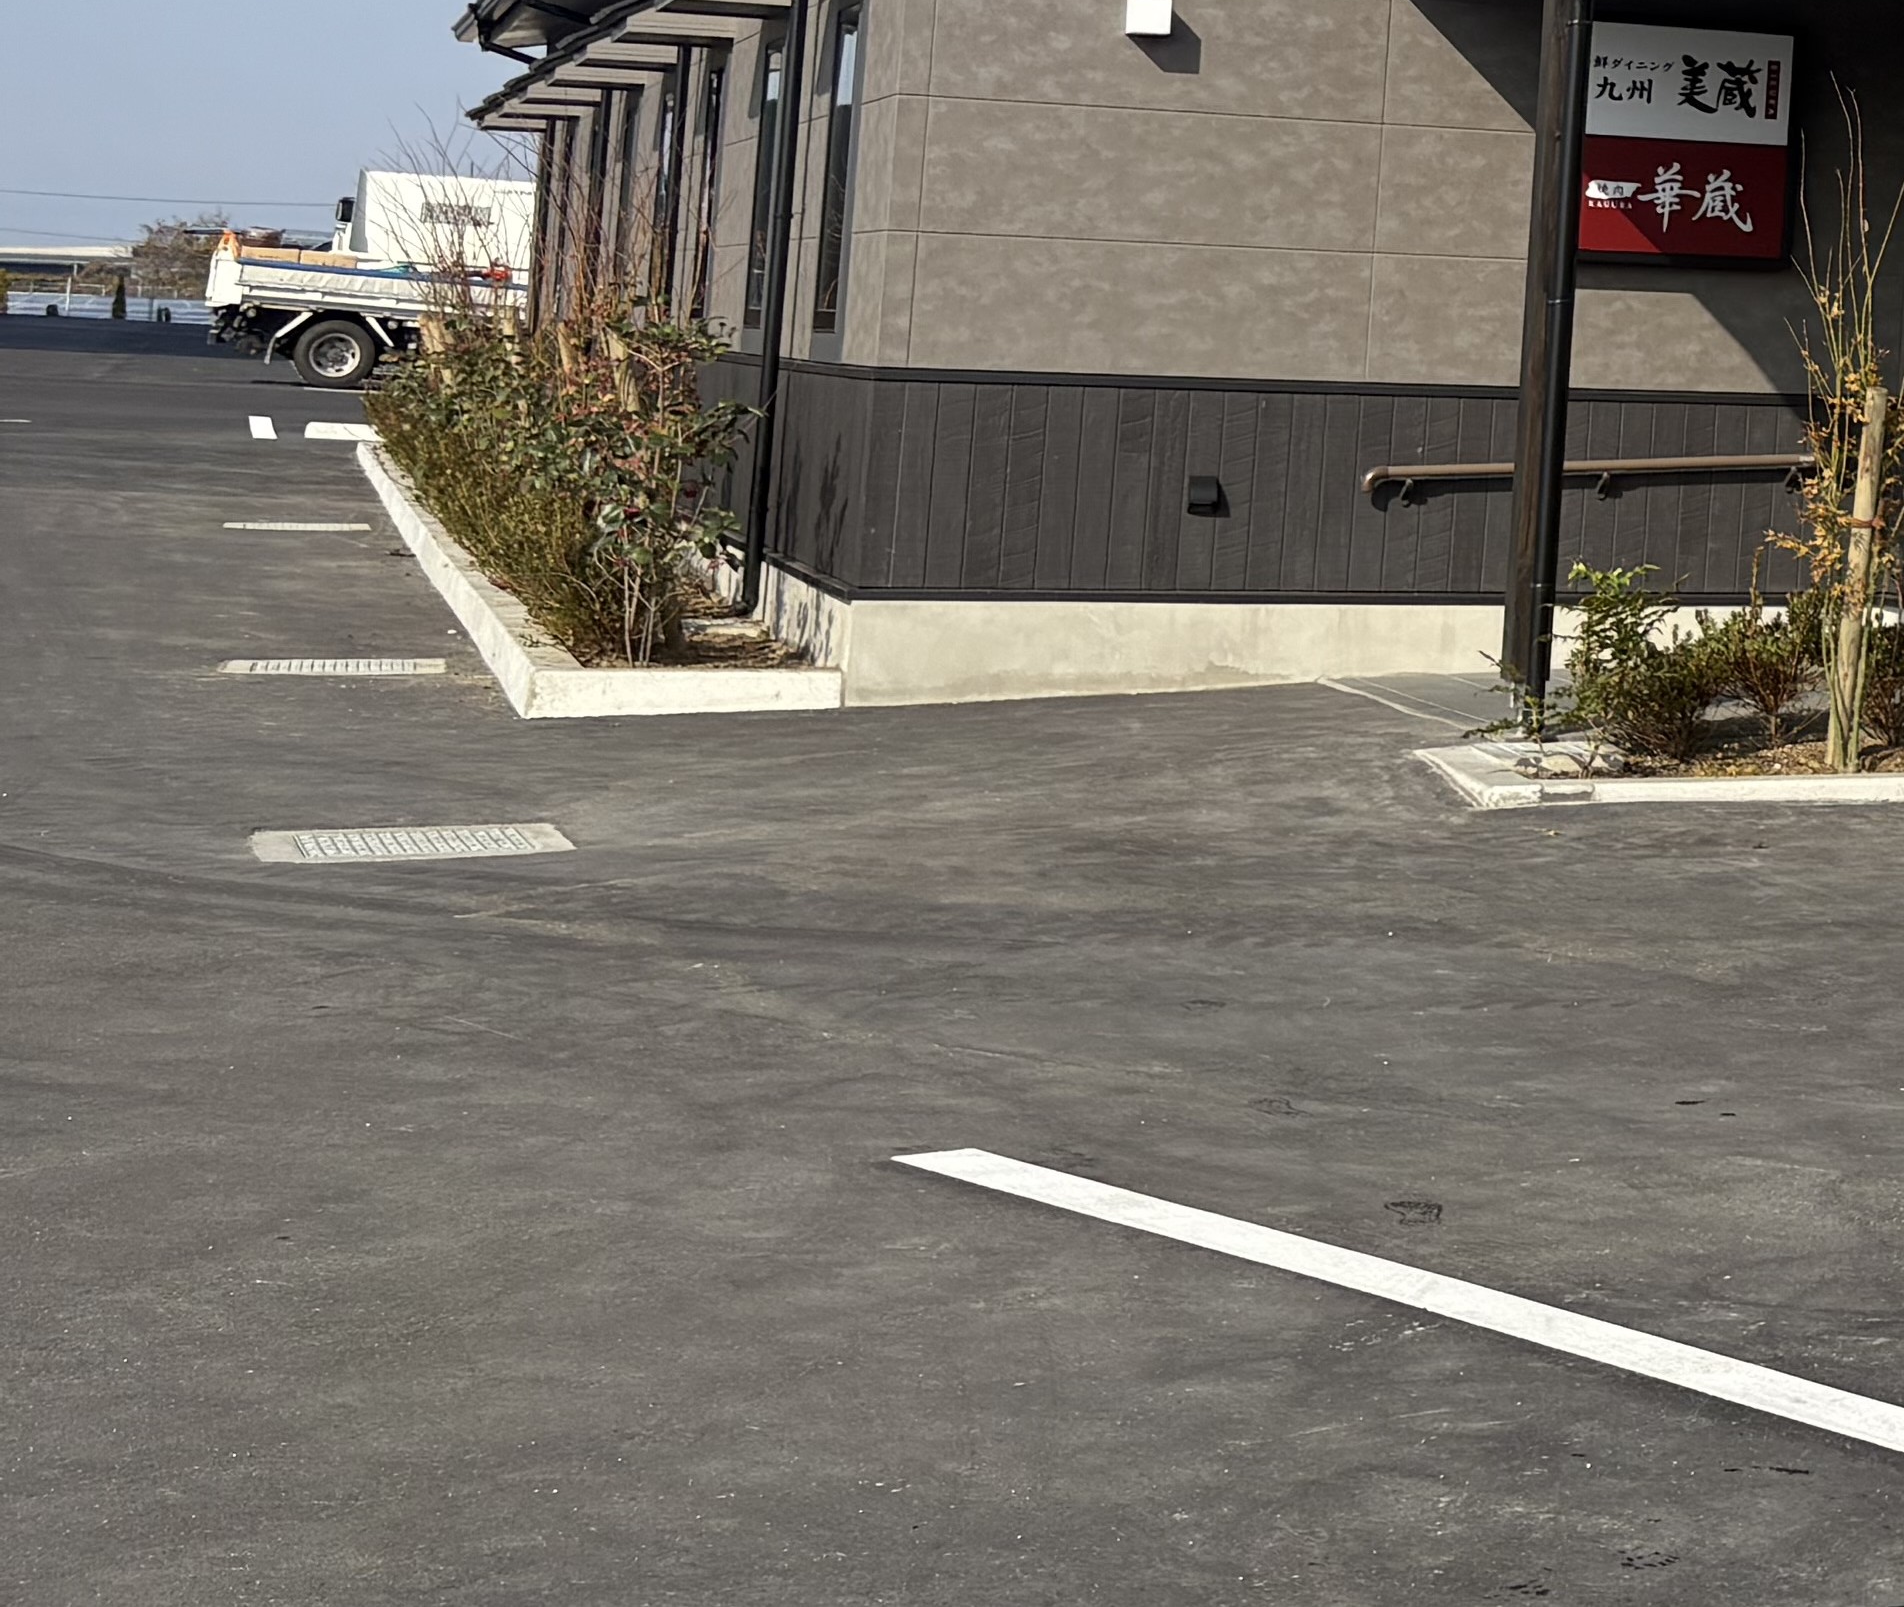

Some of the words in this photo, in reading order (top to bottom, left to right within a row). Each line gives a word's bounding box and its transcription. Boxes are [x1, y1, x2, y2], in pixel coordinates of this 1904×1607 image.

[1595, 76, 1653, 104] 九州
[1677, 54, 1762, 118] 美蔵
[1637, 162, 1753, 233] 華蔵
